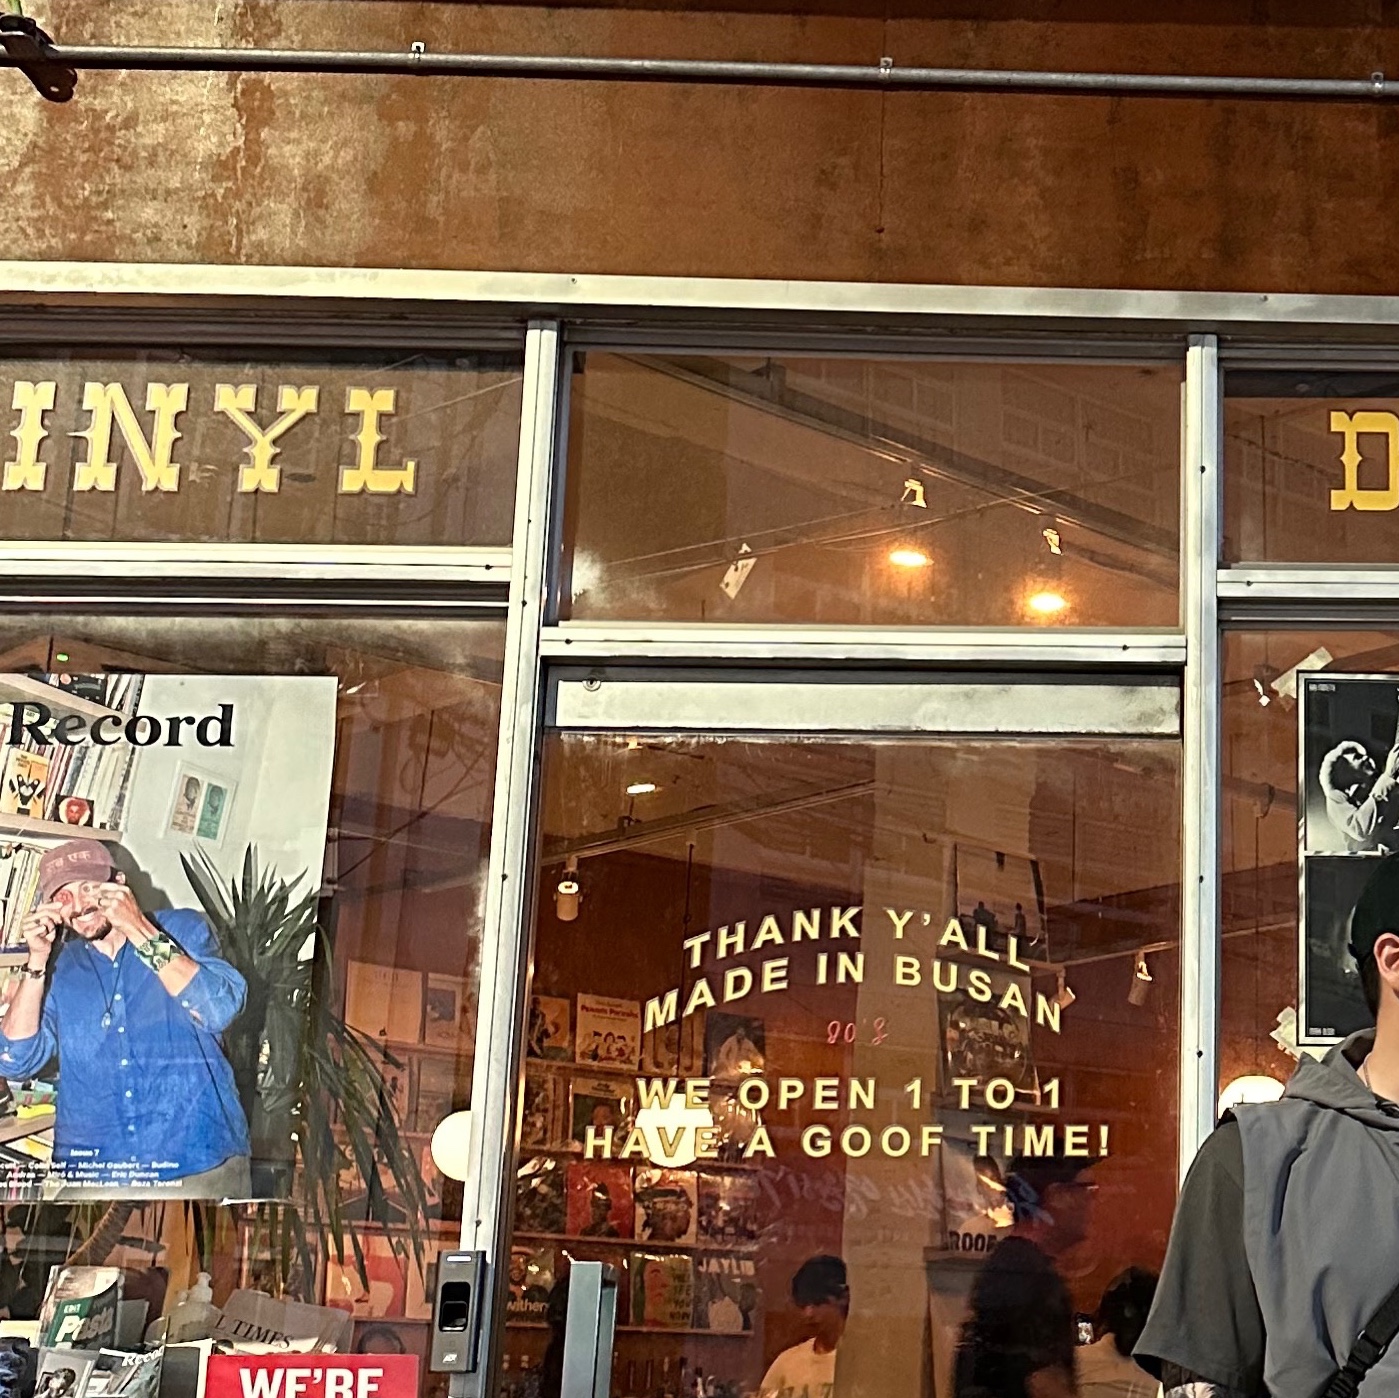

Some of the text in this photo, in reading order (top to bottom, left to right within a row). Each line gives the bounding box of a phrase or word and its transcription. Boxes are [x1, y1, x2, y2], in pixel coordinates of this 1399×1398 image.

[2, 380, 417, 494] INYL
[6, 702, 235, 747] Record
[684, 905, 1033, 973] THANK Y'ALL
[643, 952, 1062, 1034] MADE IN BUSAN
[636, 1078, 1061, 1111] WE OPEN 1 TO 1
[584, 1125, 1110, 1160] HAVE A GOOF TIME!
[232, 1319, 296, 1350] TIMES
